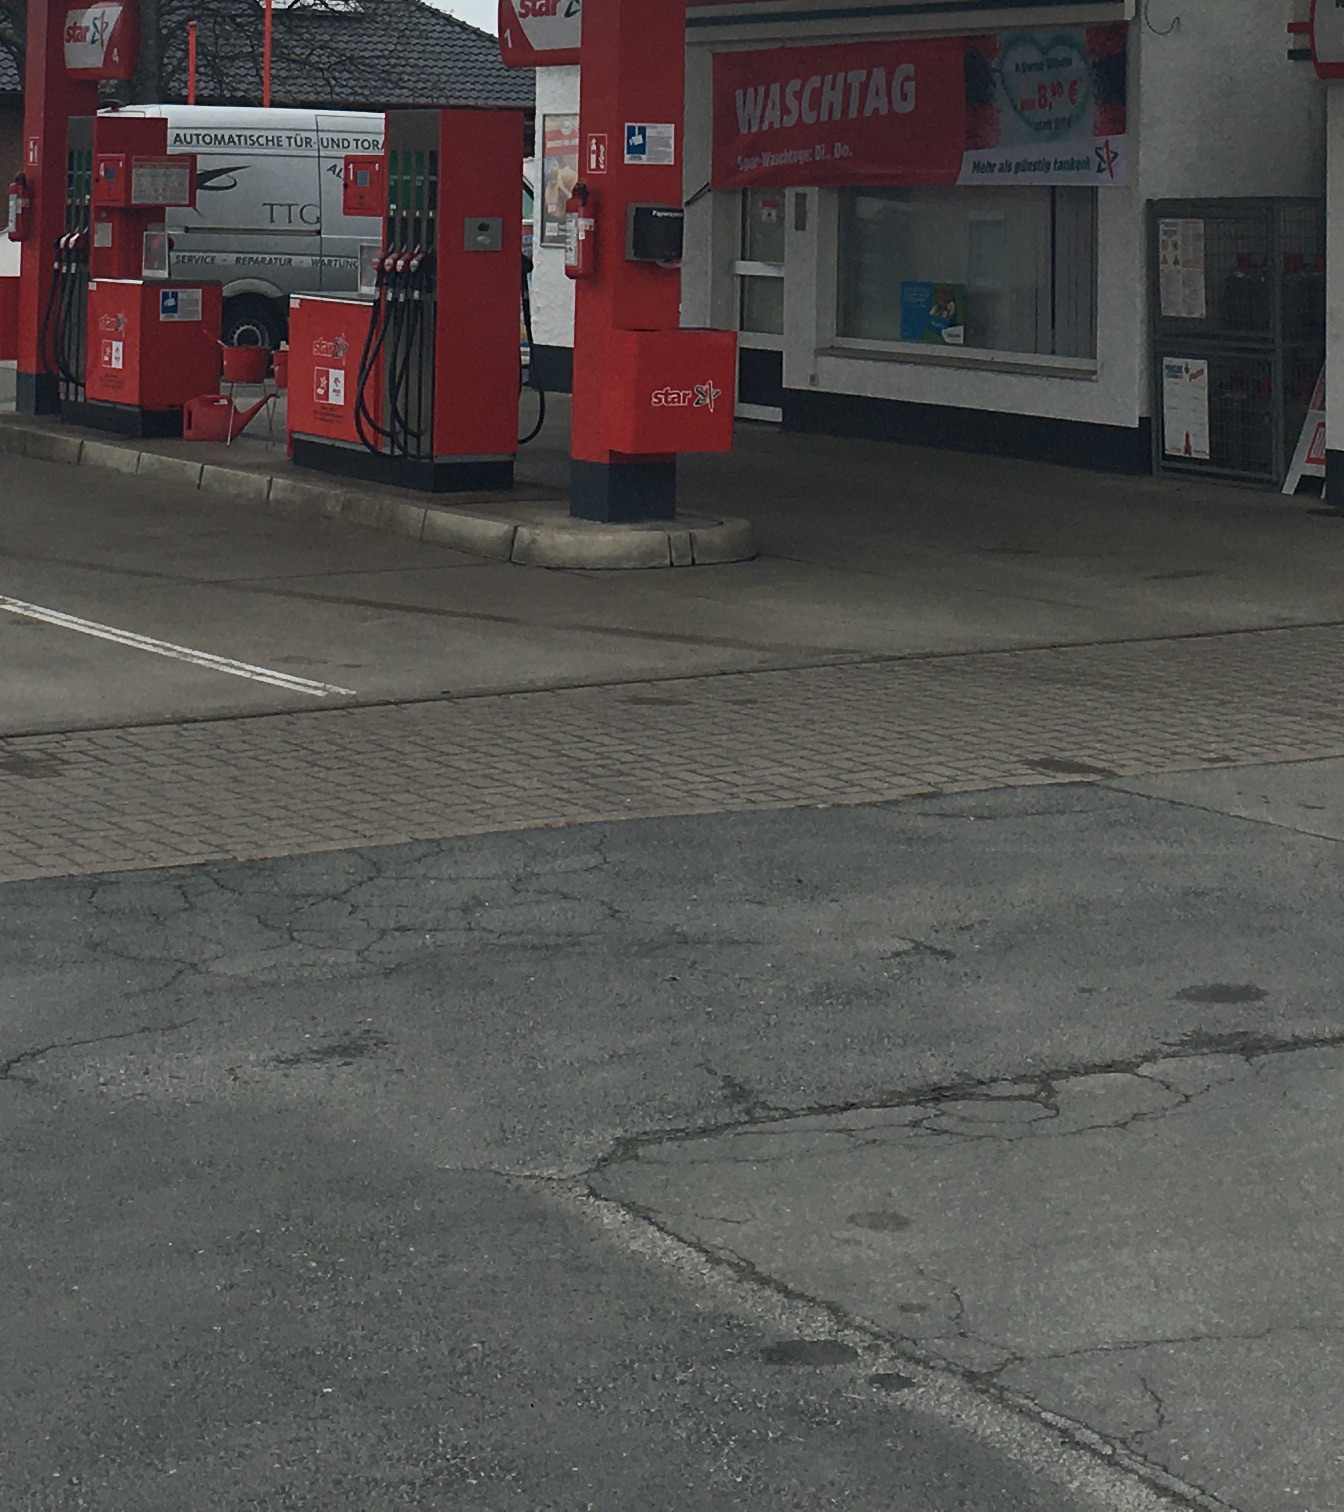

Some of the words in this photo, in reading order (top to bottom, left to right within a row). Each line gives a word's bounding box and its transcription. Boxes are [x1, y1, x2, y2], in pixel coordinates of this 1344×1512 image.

[64, 20, 91, 44] star
[503, 28, 513, 49] 1
[735, 63, 917, 134] WASCHTAG
[173, 132, 283, 148] AUTOMATISCHE
[320, 136, 351, 150] UND
[348, 163, 353, 180] 1
[972, 160, 997, 174] Mehr
[997, 160, 1012, 173] als
[262, 202, 321, 225] TTG
[175, 255, 216, 265] SERVICE
[235, 256, 293, 267] REPARATUR
[312, 336, 335, 357] star
[651, 387, 691, 407] star
